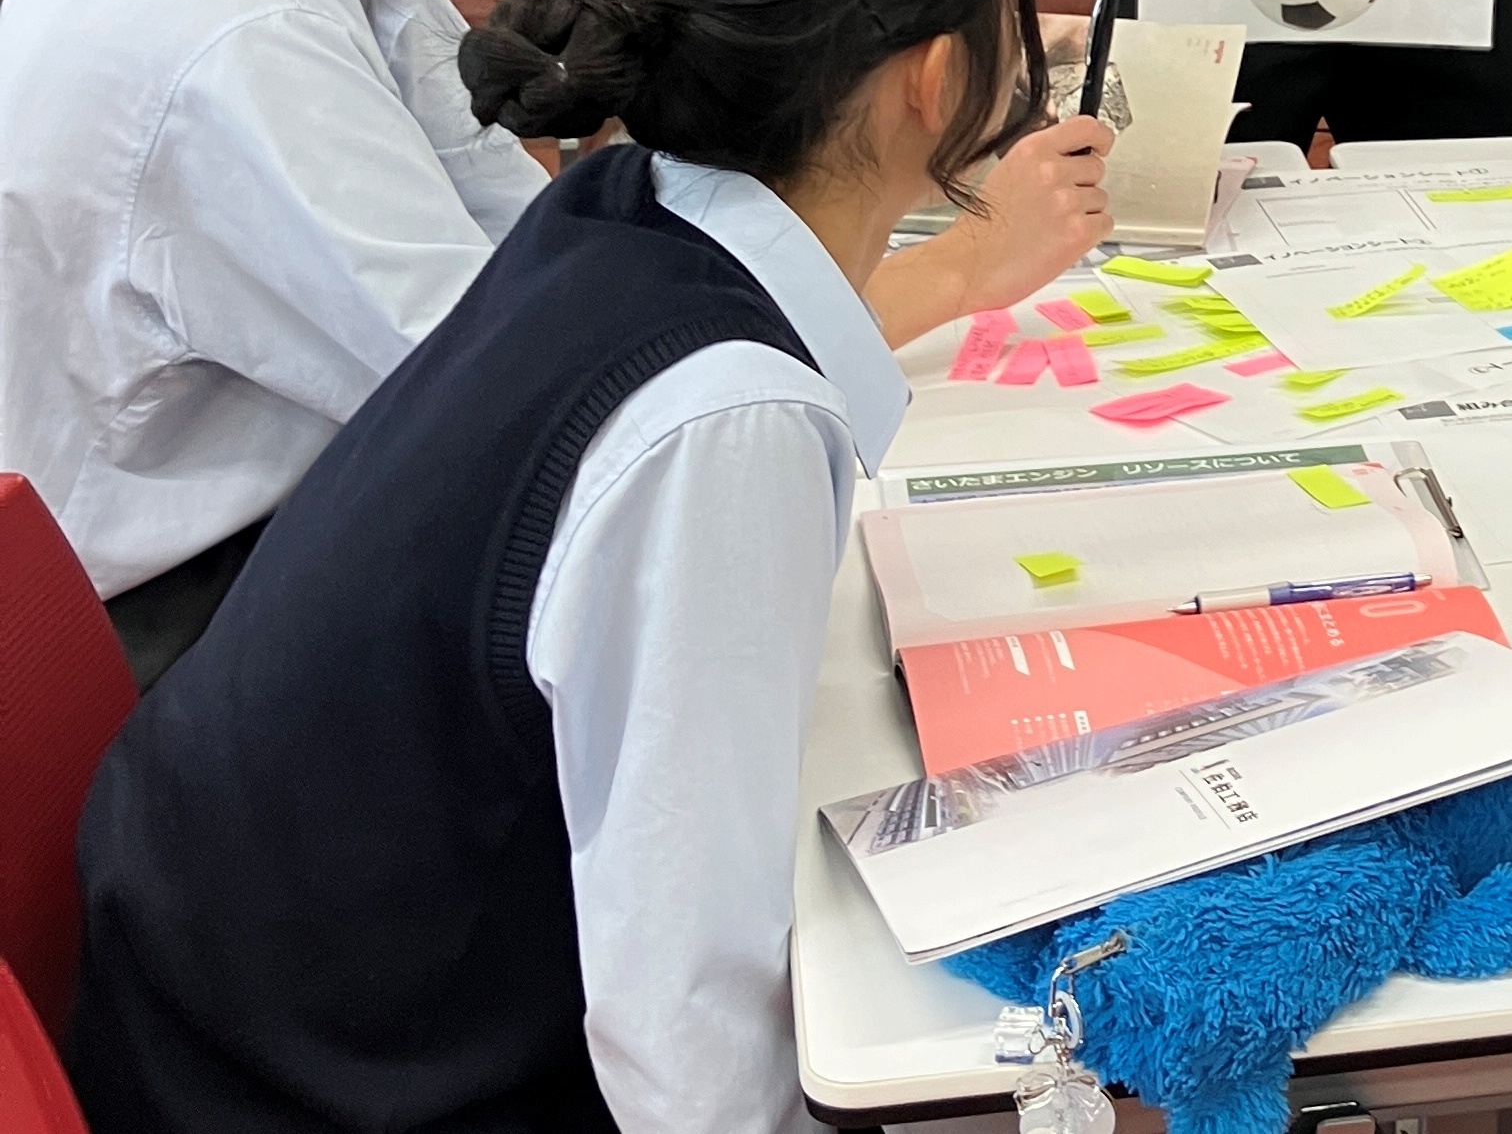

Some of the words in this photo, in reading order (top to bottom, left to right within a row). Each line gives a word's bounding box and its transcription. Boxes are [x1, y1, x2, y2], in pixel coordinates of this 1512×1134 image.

[910, 468, 1097, 491] さいたまエンジン
[1122, 452, 1301, 476] リソースについて
